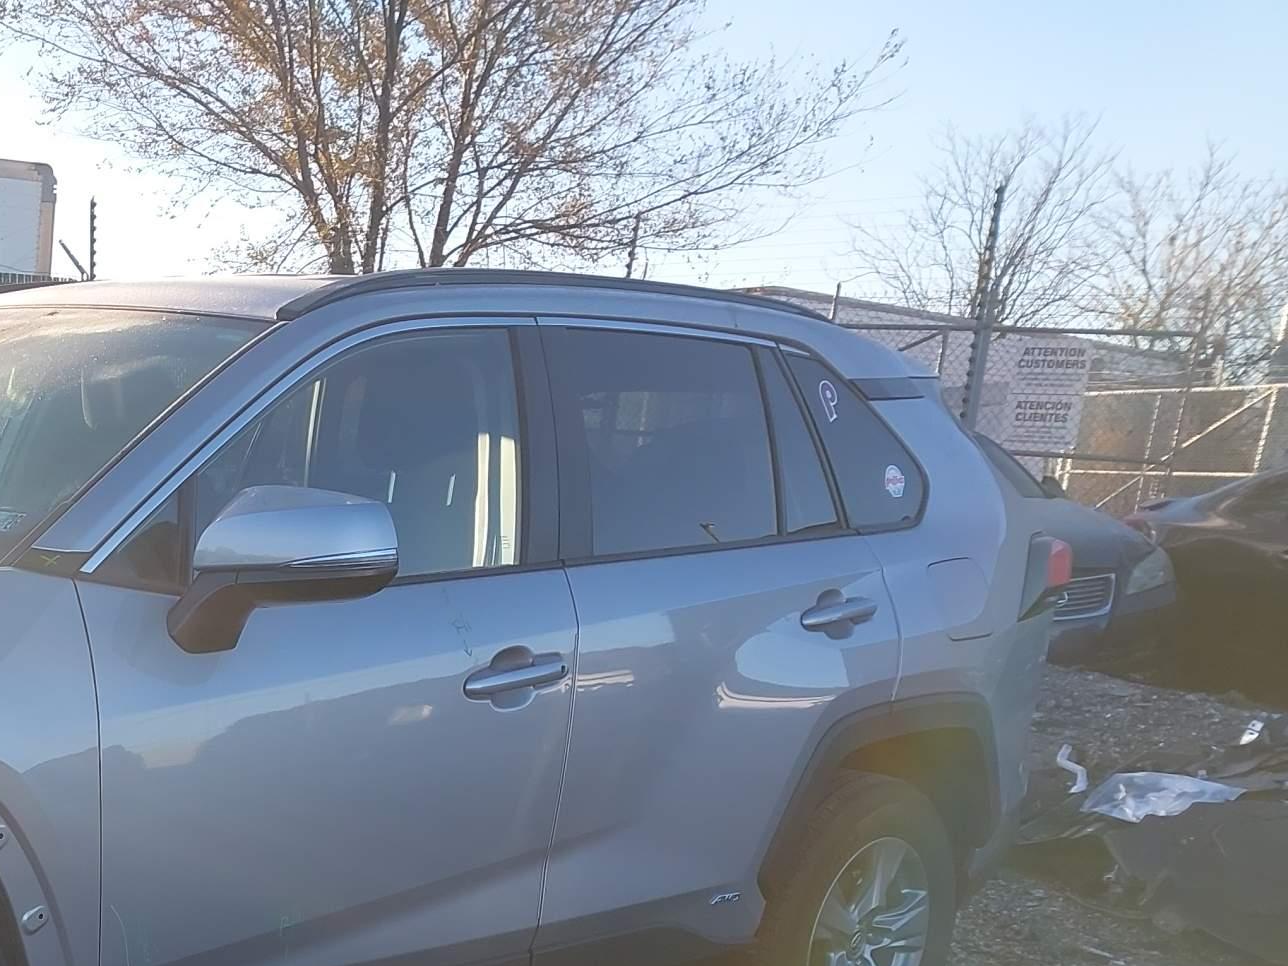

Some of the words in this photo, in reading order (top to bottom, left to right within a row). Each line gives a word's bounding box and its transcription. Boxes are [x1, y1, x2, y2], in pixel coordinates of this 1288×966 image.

[1022, 347, 1086, 357] ATTENTION
[1017, 358, 1087, 369] CUSTOMERS
[1015, 400, 1073, 412] ATENCIÓN
[1015, 412, 1069, 423] CLIENTES
